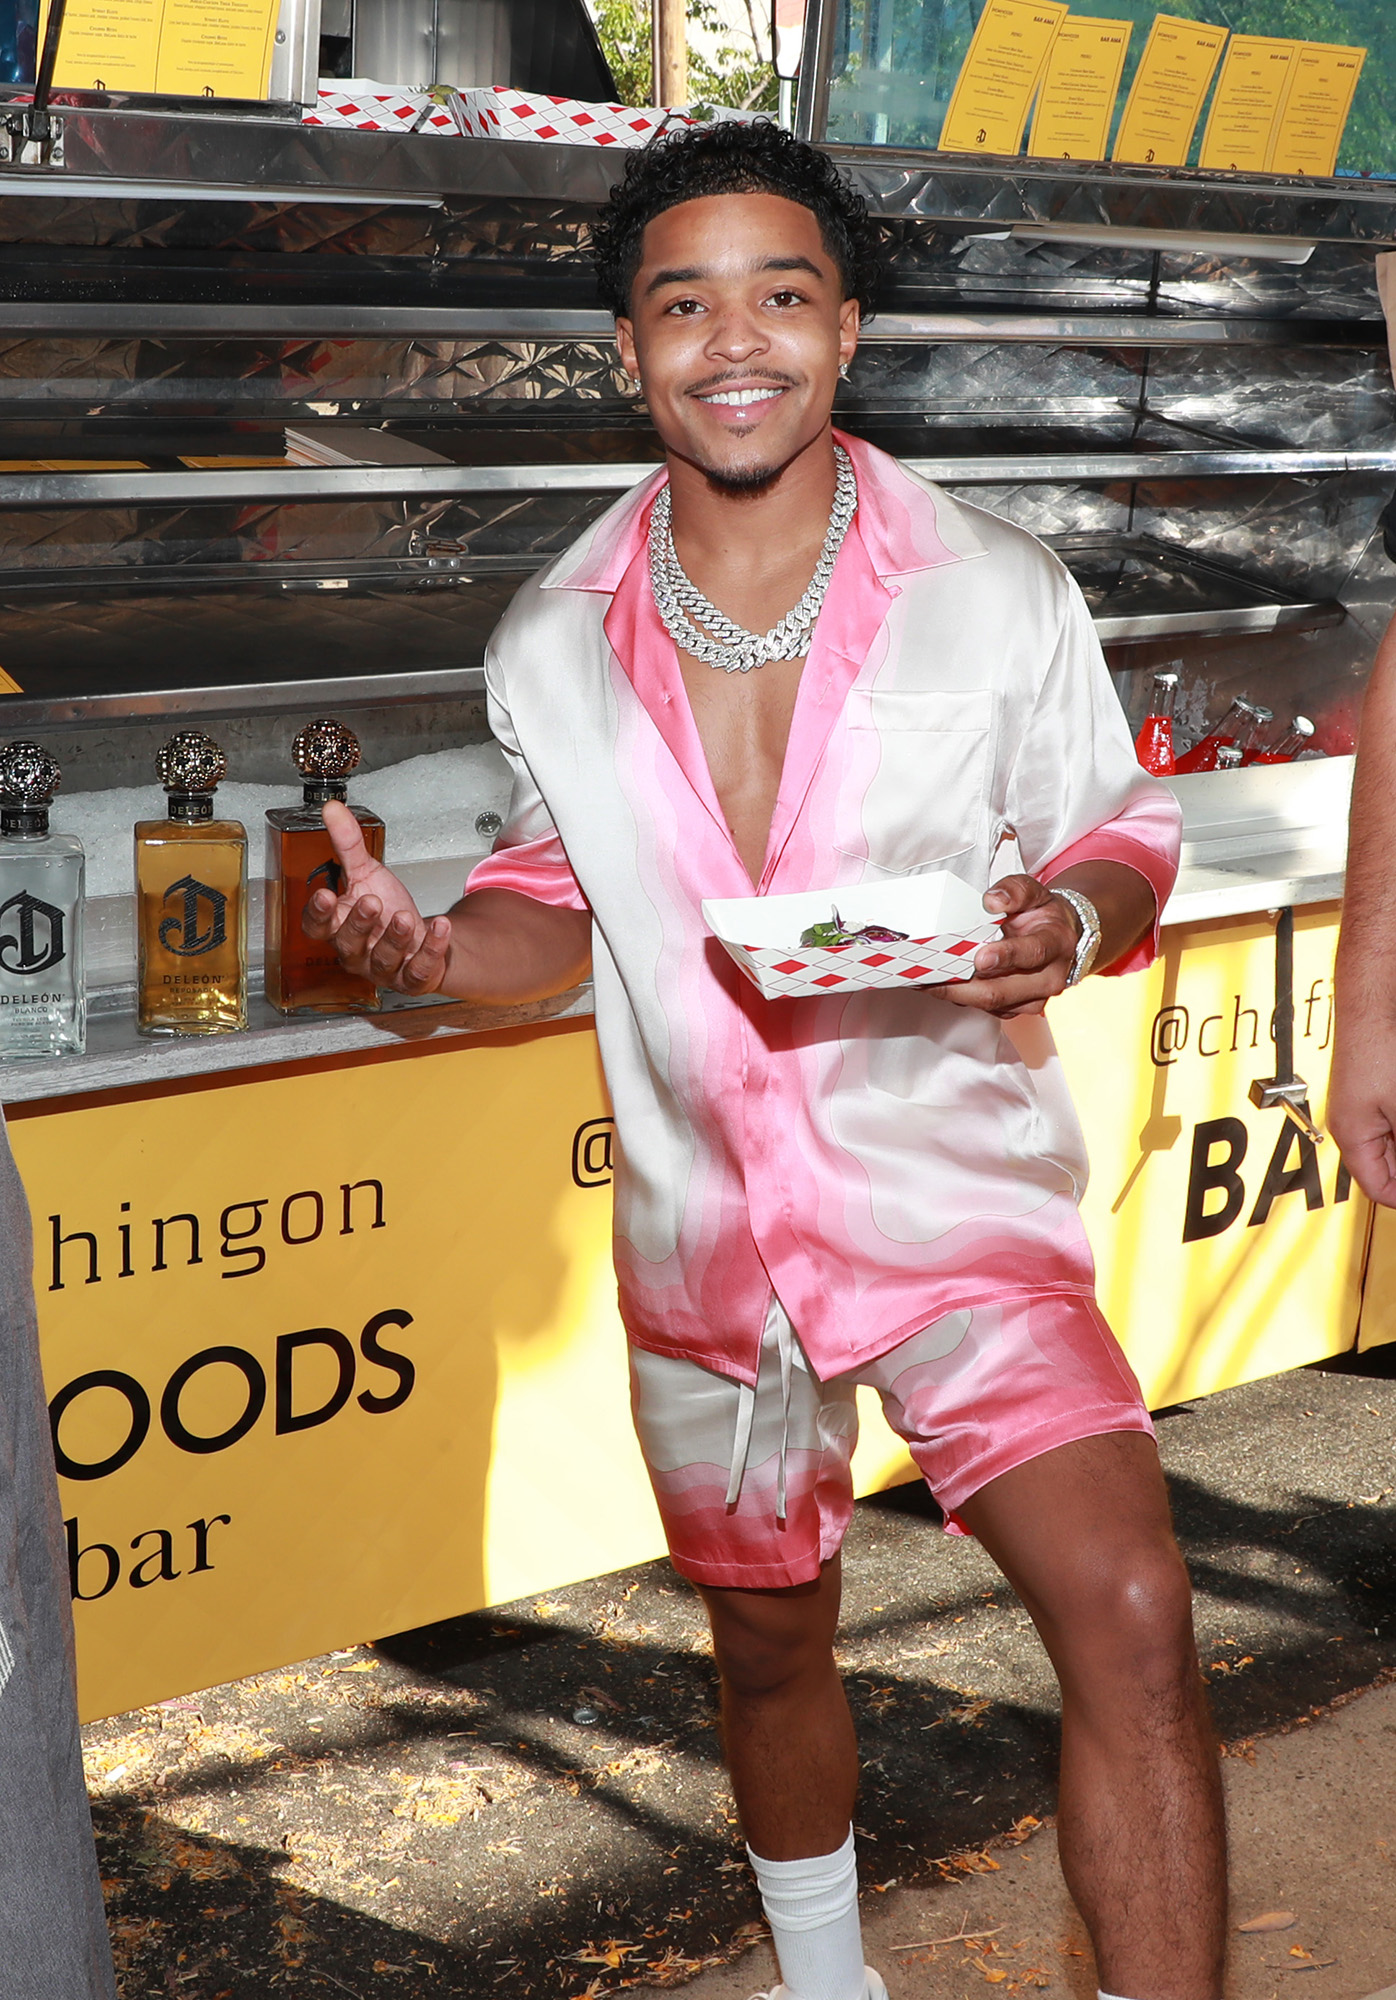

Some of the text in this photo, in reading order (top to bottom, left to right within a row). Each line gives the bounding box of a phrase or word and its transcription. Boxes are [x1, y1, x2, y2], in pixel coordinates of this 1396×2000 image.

[1, 992, 61, 1005] DELEÓN
[163, 974, 221, 985] DELEÓN
[1151, 978, 1334, 1067] @chfj
[48, 1179, 386, 1291] hingon
[48, 1308, 415, 1481] OODS
[64, 1514, 231, 1601] bar
